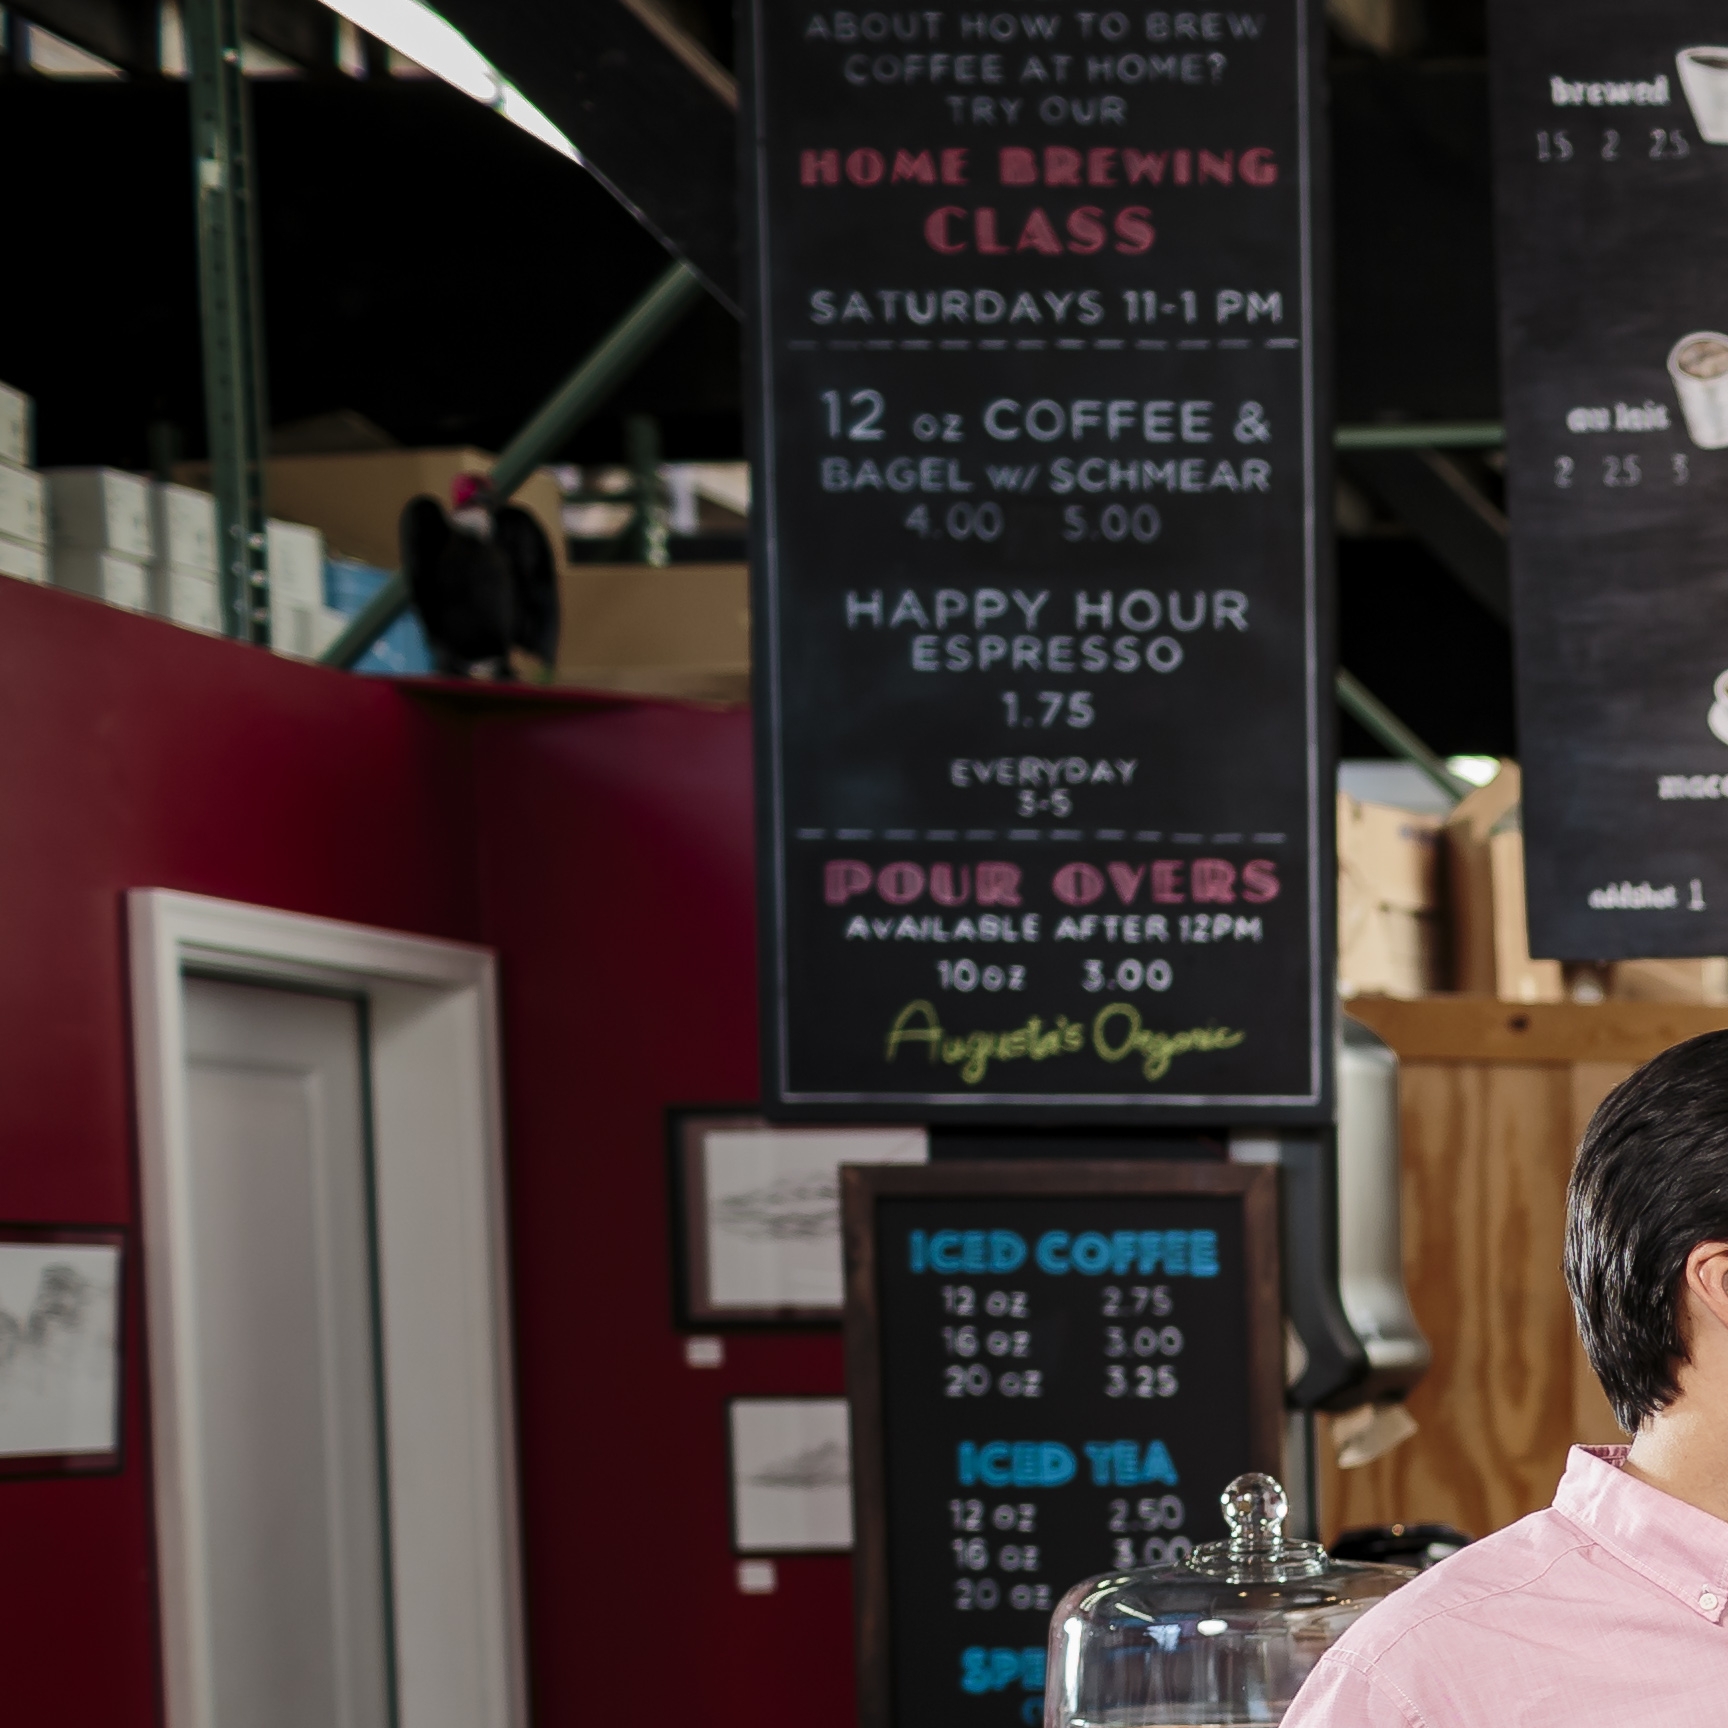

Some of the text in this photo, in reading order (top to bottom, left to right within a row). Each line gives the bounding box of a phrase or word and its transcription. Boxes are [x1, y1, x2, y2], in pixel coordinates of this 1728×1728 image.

[805, 11, 1265, 41] ABOUT HOW TO BREW
[844, 52, 1227, 87] COFFEE AT HOME?
[1550, 75, 1670, 107] brewed
[948, 95, 1128, 126] TRY OUR
[800, 145, 1279, 187] HOME BREWING
[924, 206, 1157, 255] CLASS
[810, 289, 1284, 326] SATURDAYS 11-1 PM
[821, 388, 1272, 443] 12 COFFEE &
[820, 457, 1272, 493] BAGEL SCHMEAR
[904, 502, 1160, 543] 4.00 5.00
[845, 588, 1249, 633] HAPPY HOUR
[910, 634, 1185, 674] ESPRESSO
[1001, 690, 1096, 730] 1.75
[950, 757, 1138, 787] EVERYDAY
[1017, 790, 1072, 817] 3-5
[823, 859, 1280, 905] POUR OVERS
[845, 914, 1262, 943] AVAILABLE AFTER 12PM
[1081, 959, 1173, 992] 3.00
[909, 1230, 1220, 1278] ICED COFFEE
[941, 1286, 976, 1316] 12
[957, 1441, 1178, 1487] ICED TEA
